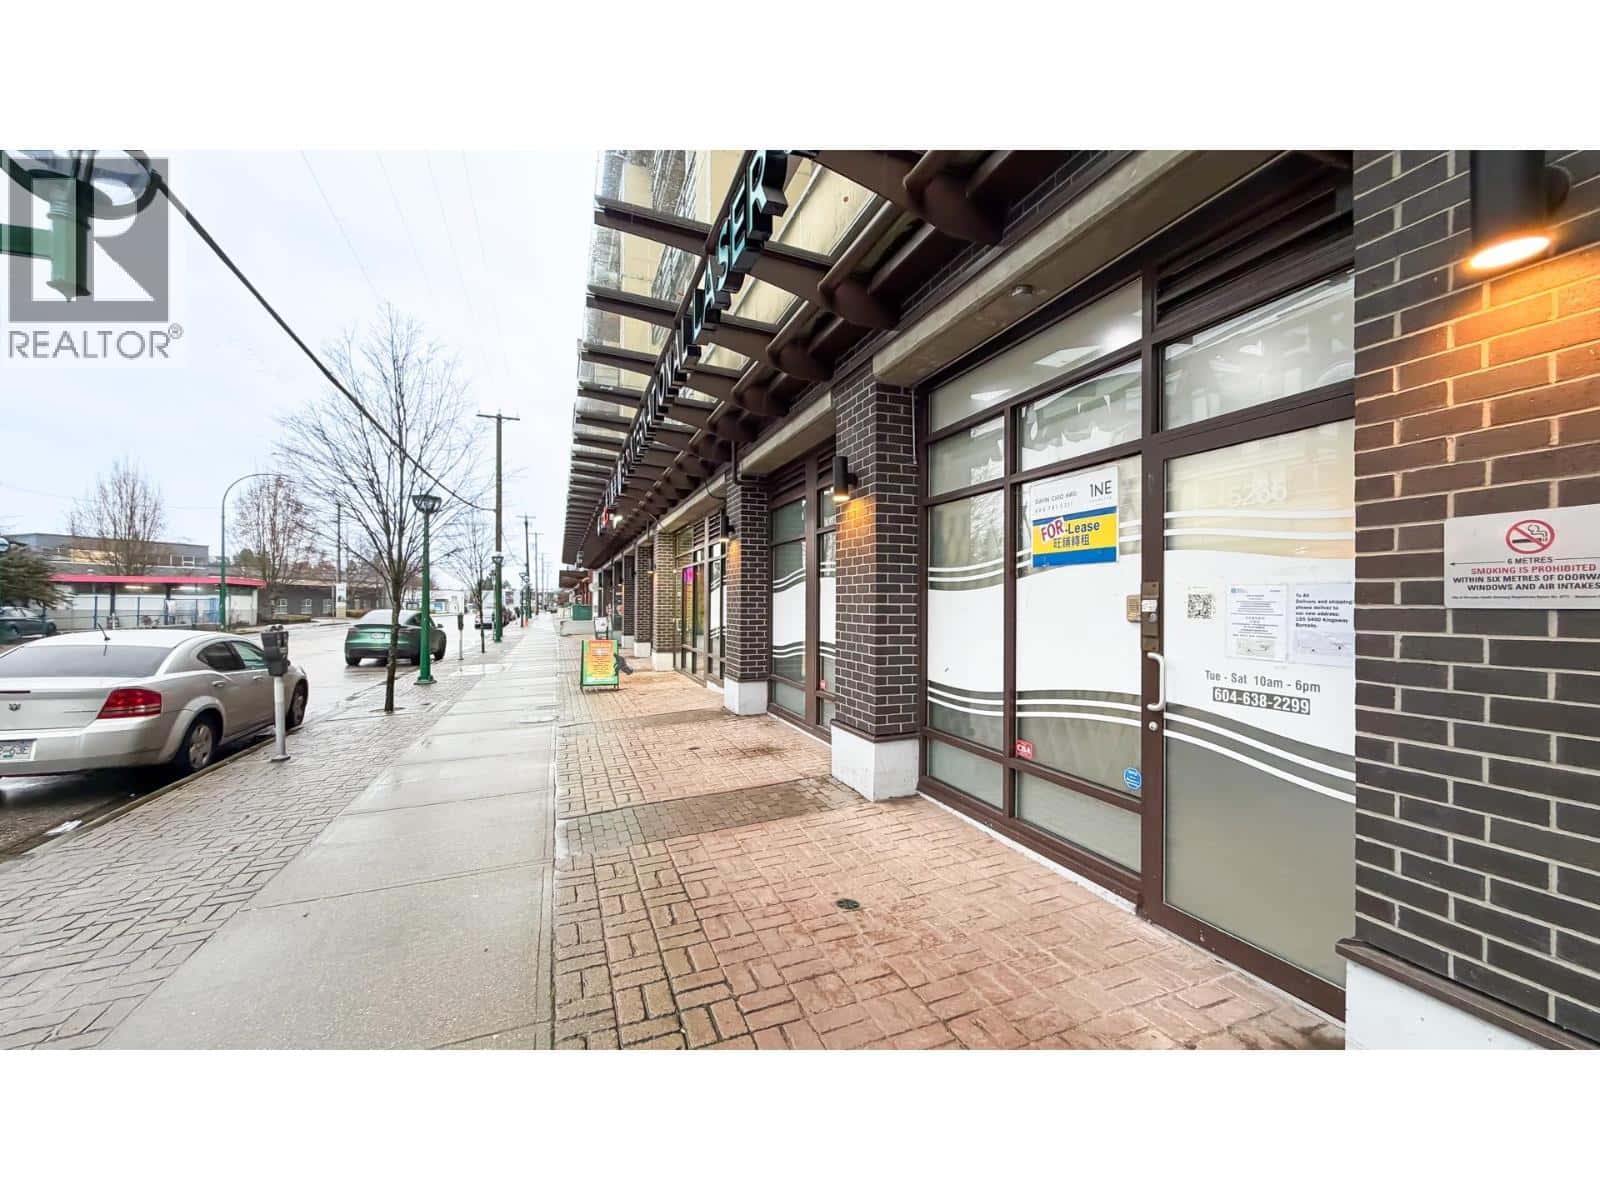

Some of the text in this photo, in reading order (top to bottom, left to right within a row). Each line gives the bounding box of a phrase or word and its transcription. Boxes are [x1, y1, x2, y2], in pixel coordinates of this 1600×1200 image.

[691, 150, 784, 346] LASER
[1041, 520, 1064, 542] FOR
[1471, 567, 1516, 575] SMOKING
[1531, 563, 1597, 573] PROHIBITED
[1515, 556, 1553, 565] METRES
[1503, 574, 1540, 582] METRES
[1467, 583, 1513, 591] WINDOWS
[1205, 670, 1221, 681] Tue
[1231, 673, 1247, 684] Sat
[1254, 676, 1283, 689] 10am
[1295, 680, 1321, 693] 6pm
[1214, 688, 1309, 714] 604-638-2299
